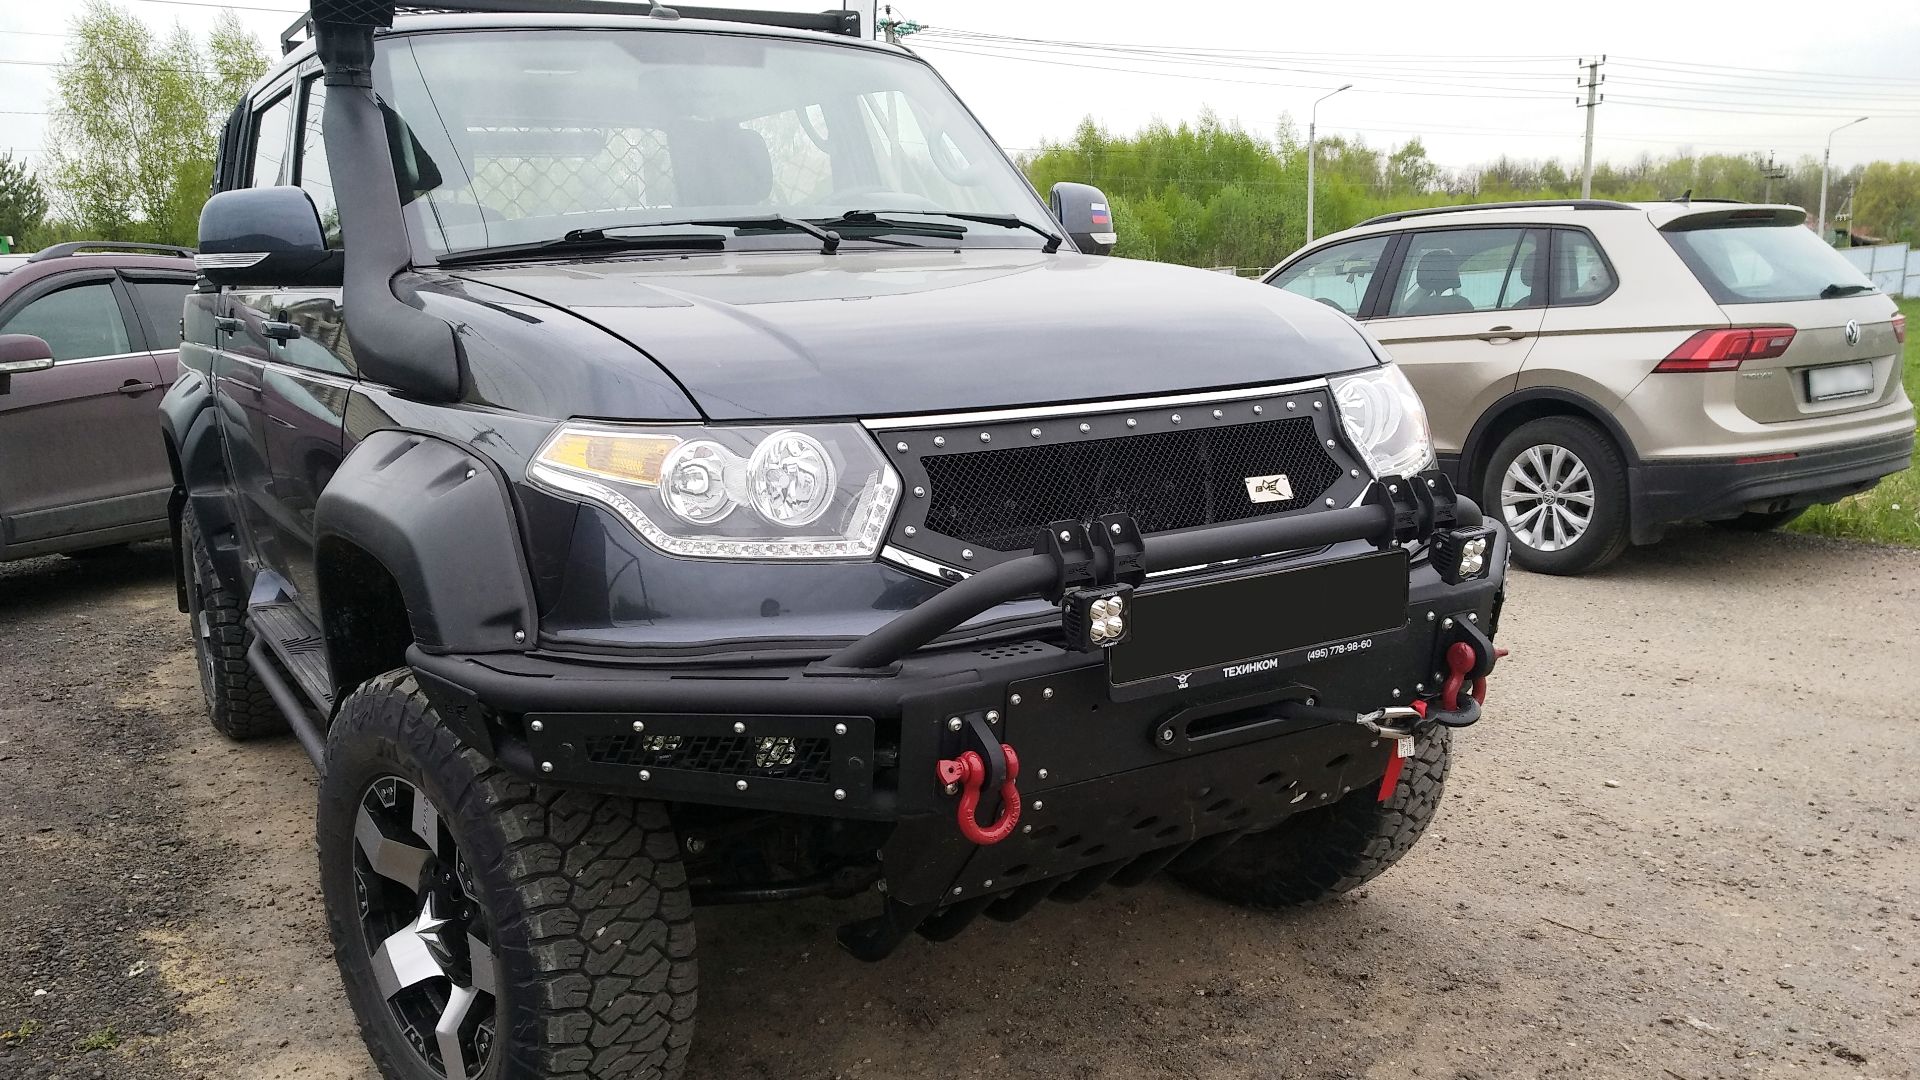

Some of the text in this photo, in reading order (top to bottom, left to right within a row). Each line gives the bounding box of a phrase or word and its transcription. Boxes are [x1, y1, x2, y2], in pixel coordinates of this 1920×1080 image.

[1307, 638, 1372, 662] (495) 778-98-60
[1222, 657, 1278, 678] ТЕХИНКОМ
